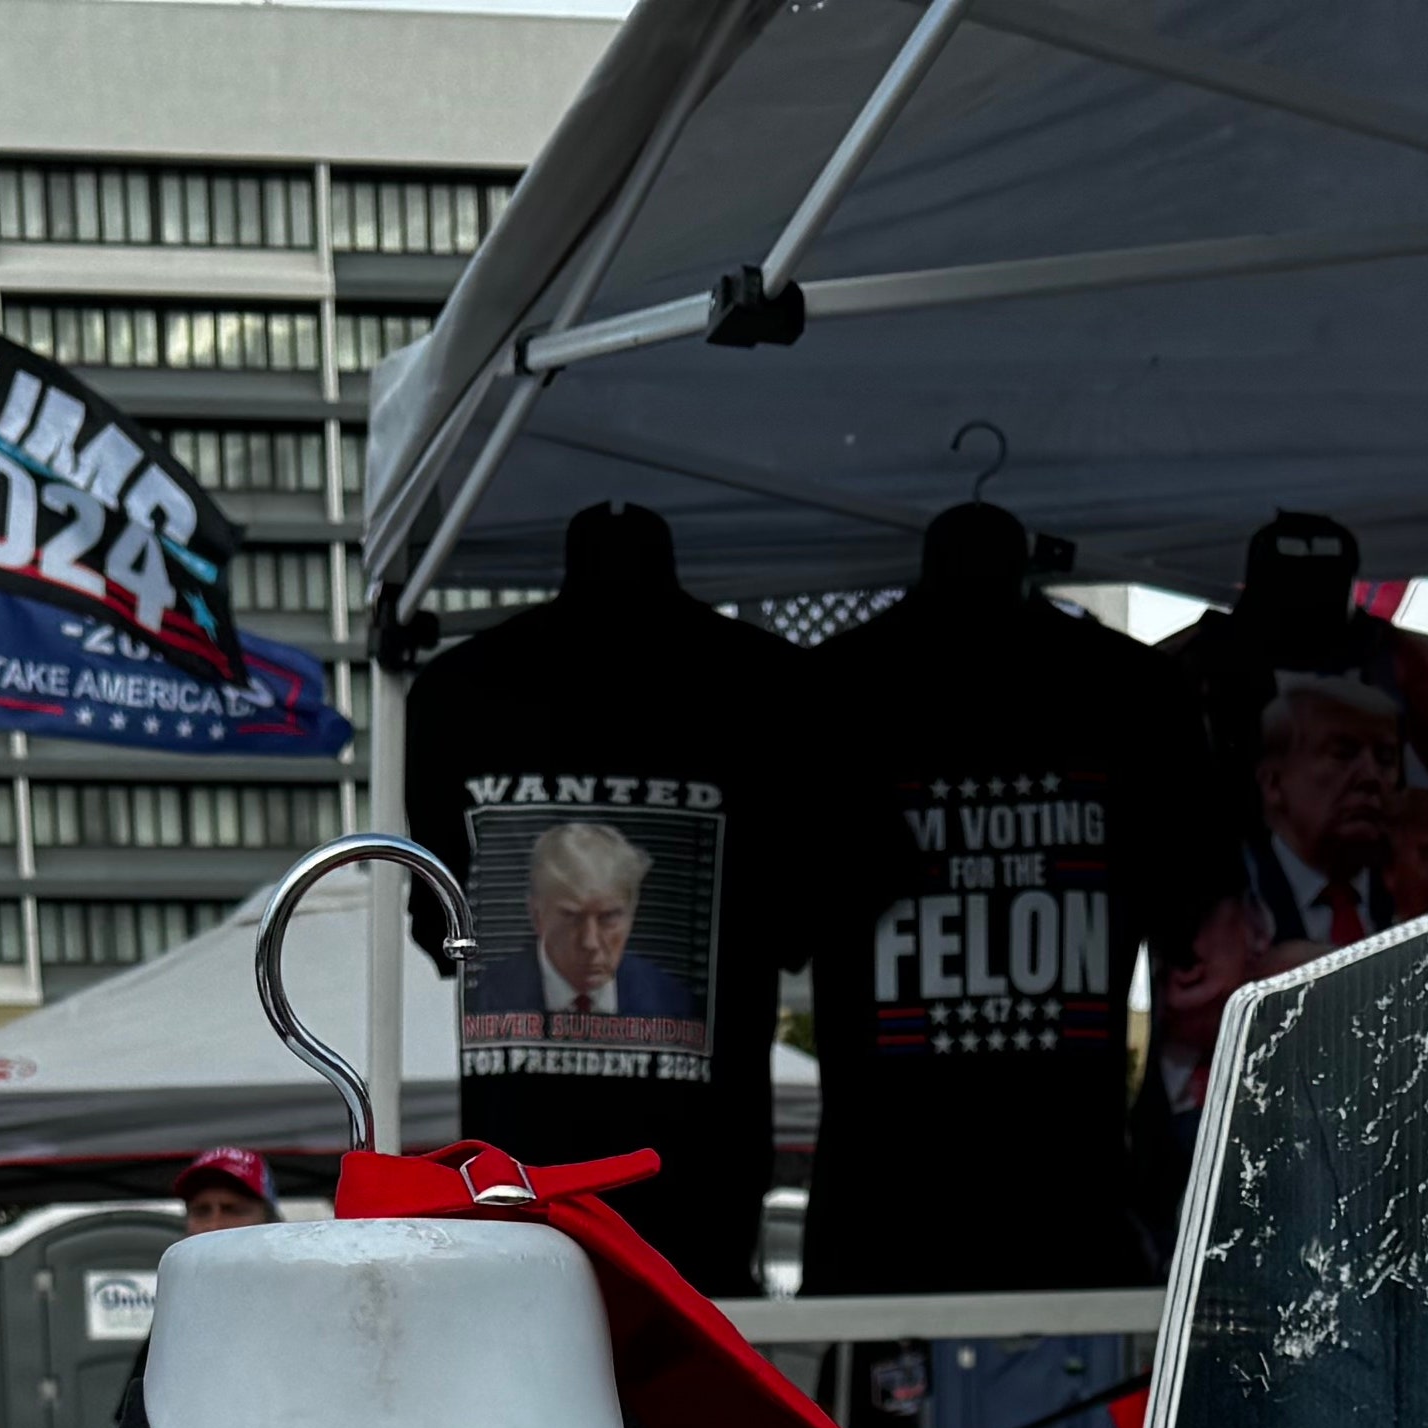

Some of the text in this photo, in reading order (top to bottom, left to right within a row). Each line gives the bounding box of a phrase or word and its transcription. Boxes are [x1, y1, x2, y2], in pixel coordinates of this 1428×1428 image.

[72, 668, 224, 715] AMERICA
[465, 774, 723, 808] WANTED
[959, 801, 1106, 850] VOTING
[949, 852, 1046, 889] FOR THE
[874, 888, 1110, 1002] FELON
[463, 1013, 545, 1039] NEVER
[462, 1049, 506, 1077] FOR
[508, 1049, 652, 1078] PRESIDENT
